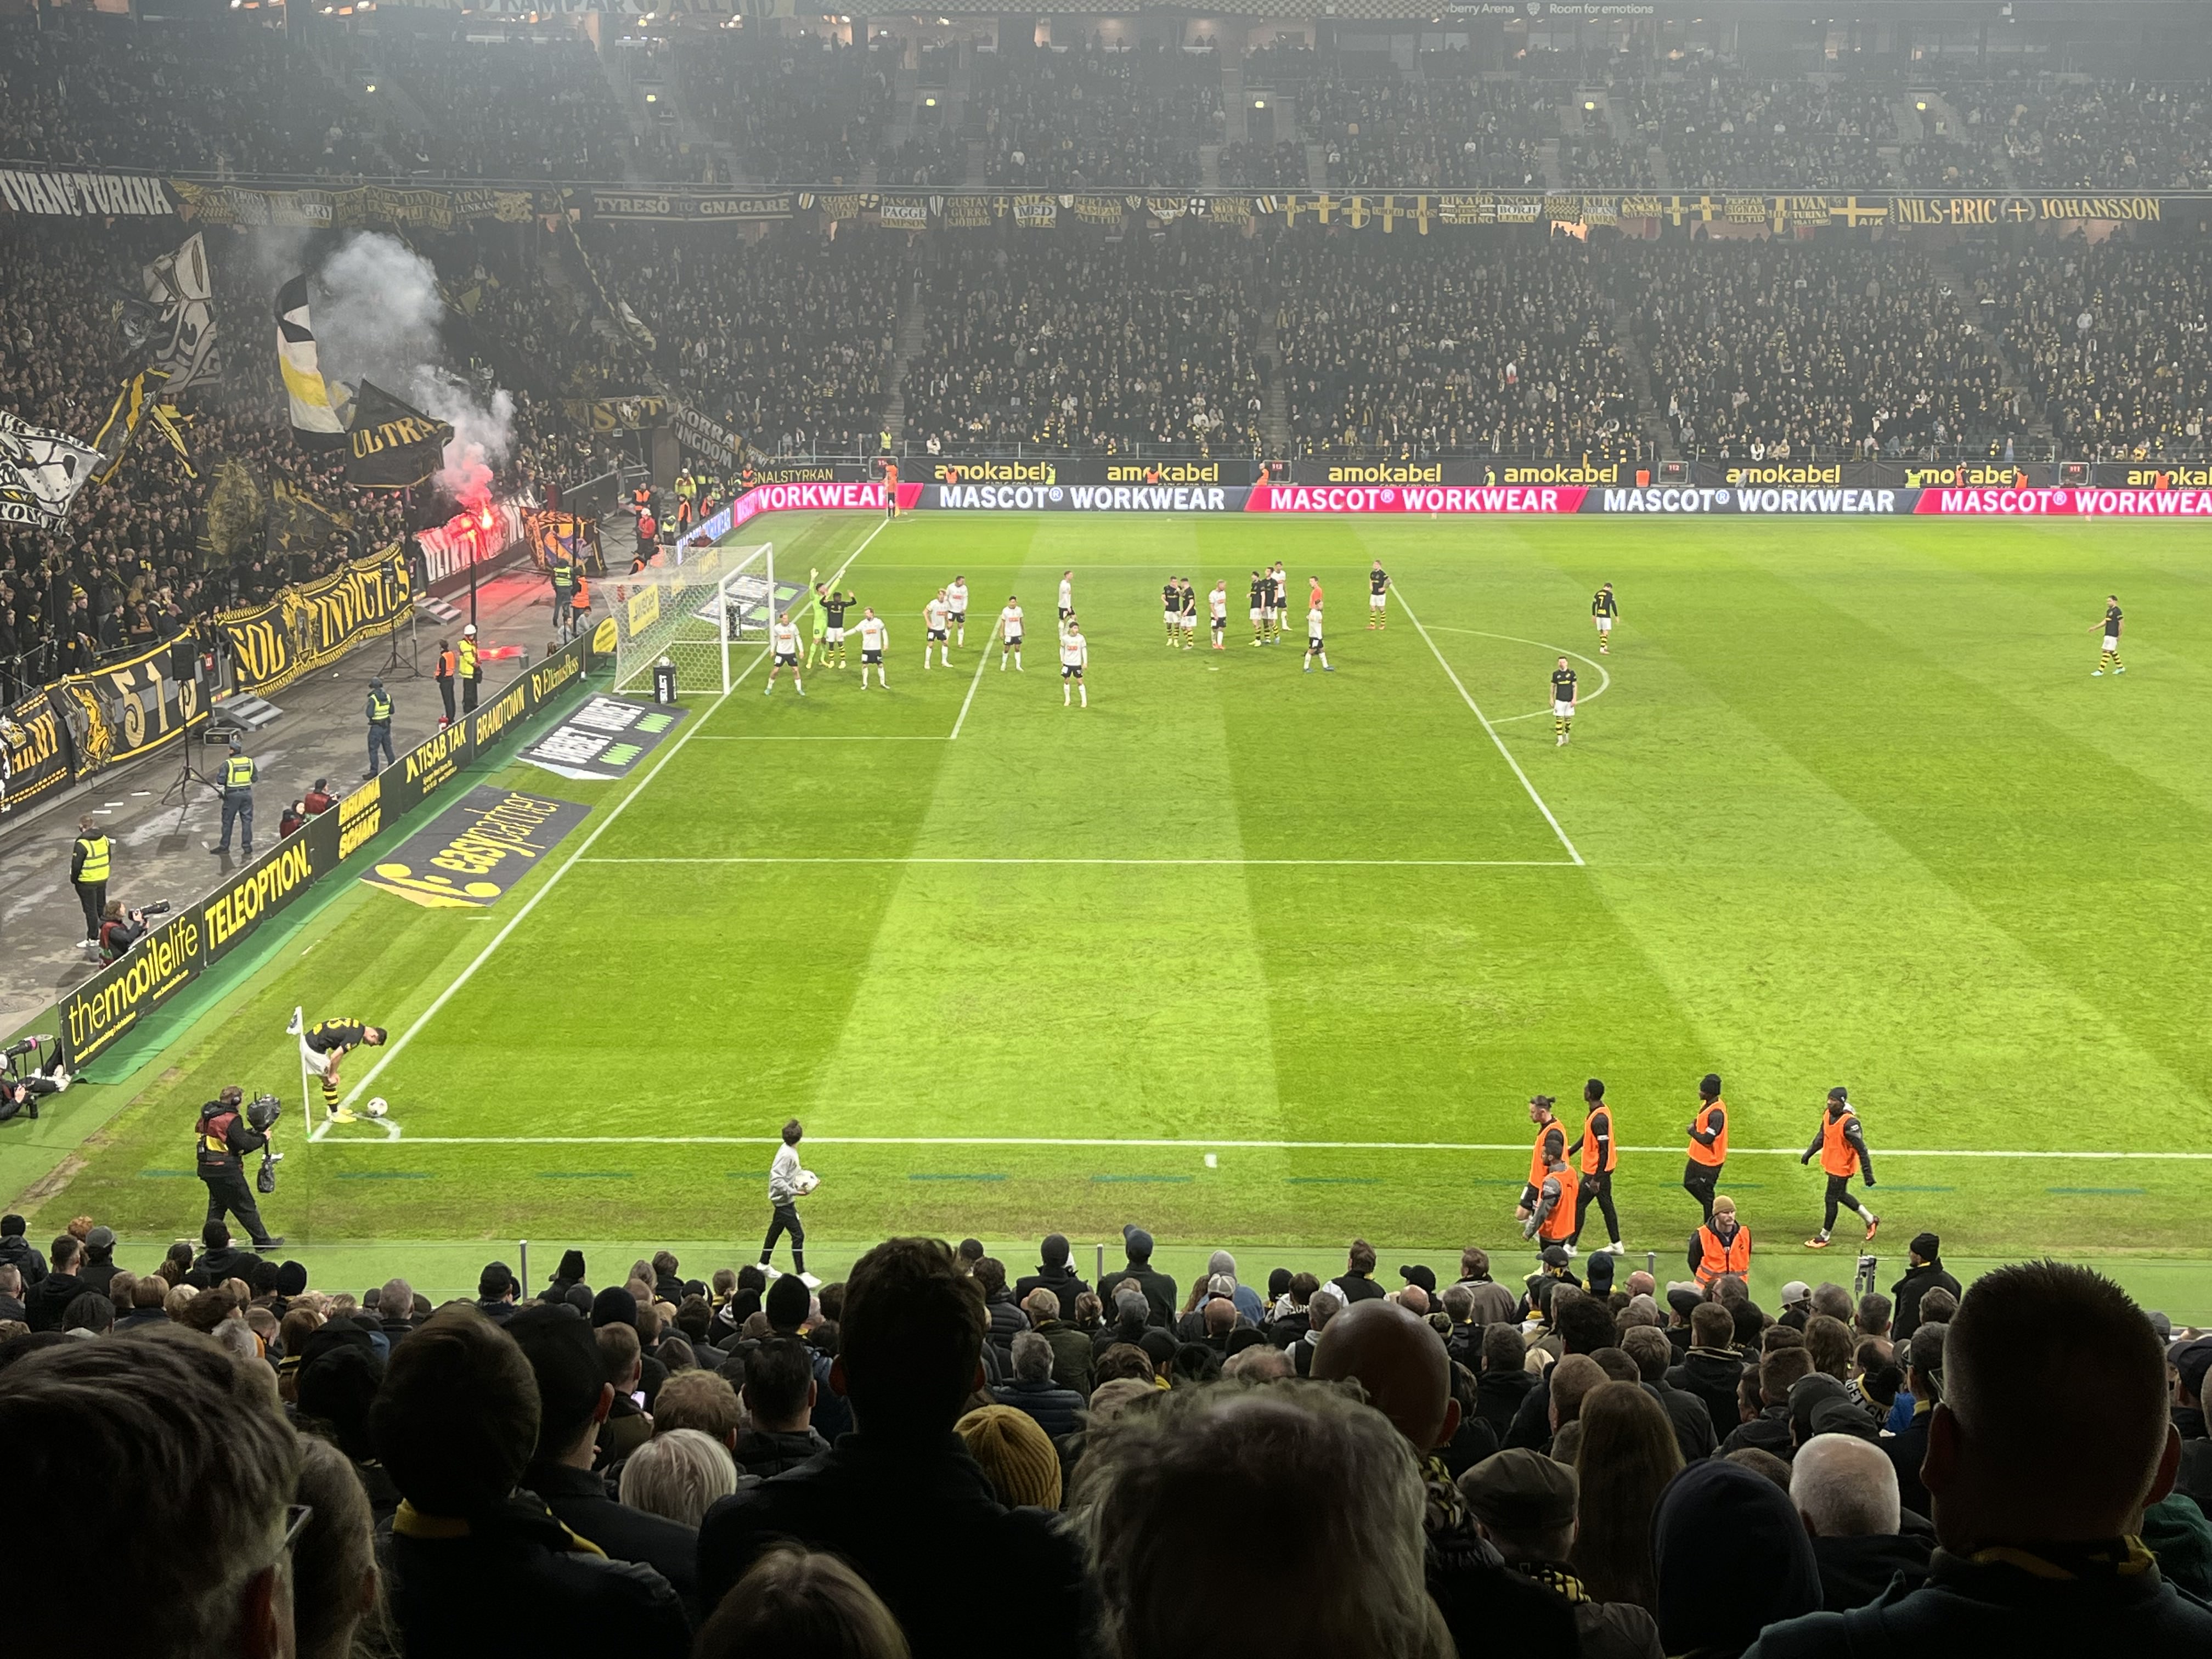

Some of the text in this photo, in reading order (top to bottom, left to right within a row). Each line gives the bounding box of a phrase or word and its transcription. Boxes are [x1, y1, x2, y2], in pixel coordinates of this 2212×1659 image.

[1447, 3, 1515, 16] berry Arena
[1549, 3, 1654, 14] Room for emotions
[0, 169, 174, 217] IVAN TURINA
[882, 196, 927, 207] PASCAL
[947, 196, 992, 208] GUSTAV
[1013, 194, 1057, 206] NILS
[1441, 196, 1494, 205] RIKARD
[1583, 196, 1618, 207] KURT
[594, 195, 670, 214] TYRESÖ
[699, 198, 791, 215] GNAGARE
[884, 207, 927, 218] PAGGE
[951, 207, 989, 218] GURRA
[1792, 196, 1827, 211] IVAN
[1898, 198, 2162, 224] NILS-ERIC JOHANSSON
[881, 218, 927, 228] SIMPSON
[1442, 216, 1494, 224] NORLING
[1728, 215, 1765, 223] ALLTID
[1792, 211, 1827, 219] TURINA
[1858, 217, 1883, 226] AIK
[752, 467, 833, 485] GNALSTYRKAN
[1328, 462, 1442, 483] amokabel
[1504, 463, 1618, 483] amokabel
[1725, 464, 1841, 483] amokabel
[1905, 465, 2018, 484] moabe
[2127, 466, 2212, 486] amoka
[1070, 487, 1226, 510] WORKWEAR
[1402, 489, 1558, 511] WORKWEAR
[1737, 489, 1895, 512] WORKWEAR
[227, 553, 411, 681] SOL INVICTUS
[476, 684, 526, 746] BRANDTOWN
[447, 720, 467, 753] TAK
[338, 776, 381, 827] BRUNNA
[338, 807, 381, 860] SCHAKT
[430, 792, 561, 874] easypartner
[204, 839, 312, 950] TELEOPTION.
[69, 916, 199, 1047] themobilelife
